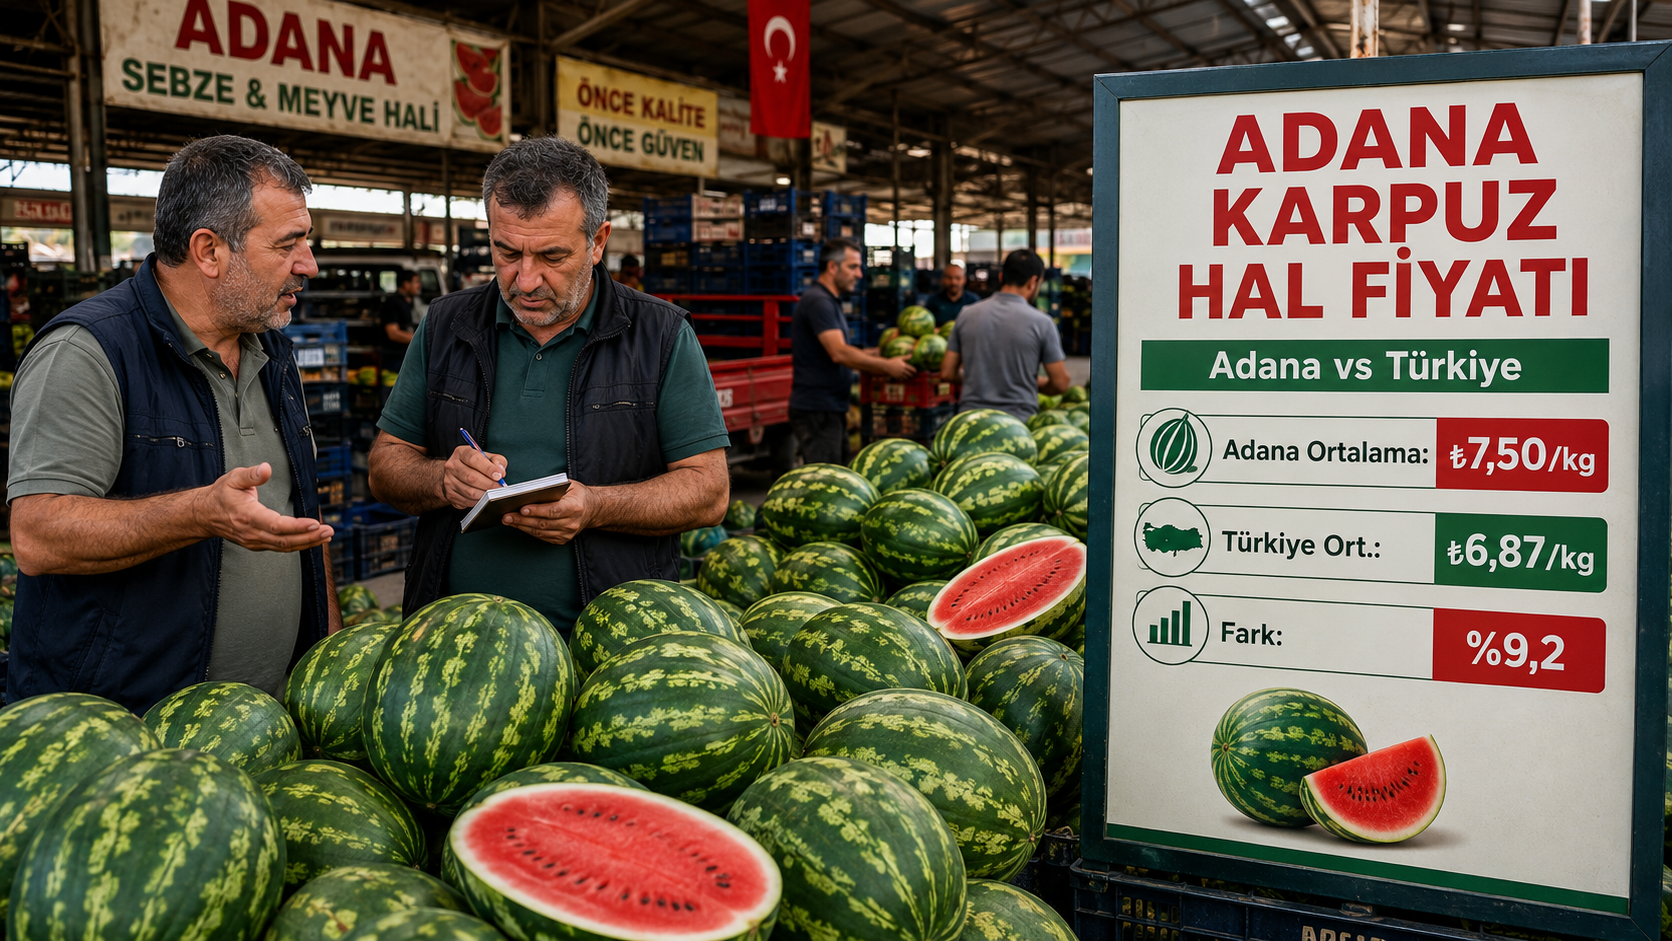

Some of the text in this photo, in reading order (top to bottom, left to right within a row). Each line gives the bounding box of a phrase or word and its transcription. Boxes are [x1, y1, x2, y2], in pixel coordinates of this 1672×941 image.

[174, 0, 398, 86] ADANA
[122, 57, 440, 133] SEBZE & MEYVE HALİ
[577, 76, 706, 129] ÖNCE KALİTE
[577, 115, 705, 163] ÖNCE GÜVEN
[1217, 103, 1539, 174] ADANA
[1213, 178, 1557, 247] KARPUZ
[1178, 246, 1589, 319] HAL FİYATI
[1209, 350, 1521, 387] Adana vs Türkiye
[1222, 438, 1430, 465] Adana Ortalama:
[1221, 530, 1381, 560] Türkiye Ort.:
[1221, 621, 1283, 647] Fark:
[1466, 630, 1566, 675] %9,2
